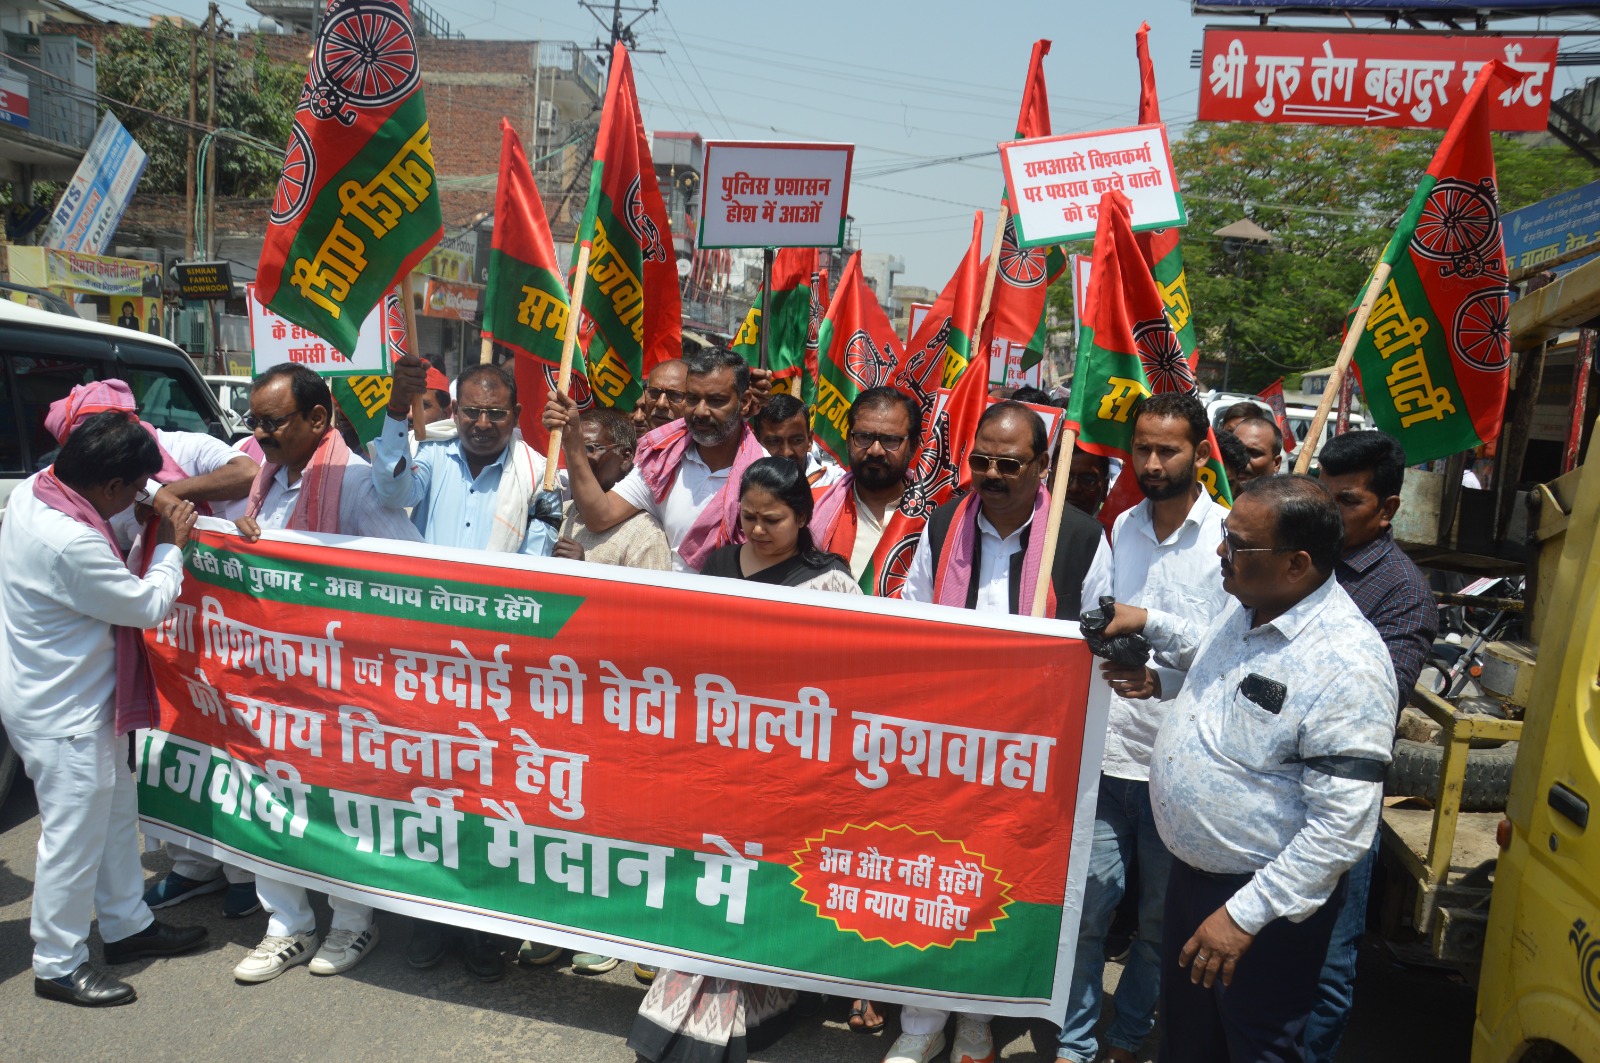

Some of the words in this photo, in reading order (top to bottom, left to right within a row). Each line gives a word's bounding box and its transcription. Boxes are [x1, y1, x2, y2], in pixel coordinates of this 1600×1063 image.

[1209, 39, 1248, 98] श्री
[1254, 56, 1304, 117] गुरु
[1311, 39, 1358, 102] तेग
[1365, 59, 1455, 123] बहादुर
[1024, 152, 1086, 178] रामआसरे
[1088, 142, 1151, 169] विश्वकर्मा
[721, 172, 770, 201] पुलिस
[774, 178, 831, 196] प्रशासन
[1023, 186, 1043, 202] पर
[726, 200, 758, 223] होश
[762, 200, 777, 223] में
[779, 201, 823, 223] आओं
[1062, 202, 1083, 223] को
[182, 284, 229, 292] SHOWROOM
[186, 267, 217, 275] SIMRAN
[189, 276, 218, 284] FAMILY
[288, 344, 326, 363] फांसी
[1386, 347, 1456, 429] पार्टी
[192, 547, 218, 575] बेटी
[222, 557, 243, 582] की
[248, 566, 304, 593] पुकार
[325, 576, 363, 599] अब
[368, 581, 423, 608] न्याय
[429, 585, 488, 616] लेकर
[494, 594, 542, 624] रहेंगे
[201, 596, 344, 690] विश्वकर्मा
[353, 653, 384, 687] एवं
[390, 639, 513, 722] हरदोई
[525, 654, 587, 725] की
[599, 660, 681, 739] बेटी
[694, 673, 837, 762] शिल्पी
[851, 711, 1057, 793] कुशवाहा
[179, 667, 227, 725] को
[225, 693, 326, 757] न्याय
[338, 705, 498, 786] दिलाने
[511, 727, 589, 820] हेतु
[329, 787, 464, 869] पार्टी
[481, 798, 675, 909] मैदान
[694, 833, 763, 925] में
[819, 846, 853, 875] अब
[856, 847, 894, 882] और
[898, 855, 935, 888] नहीं
[938, 860, 984, 898] सहेंगे
[826, 883, 860, 913] अब
[865, 889, 910, 921] न्याय
[914, 895, 970, 931] चाहिए
